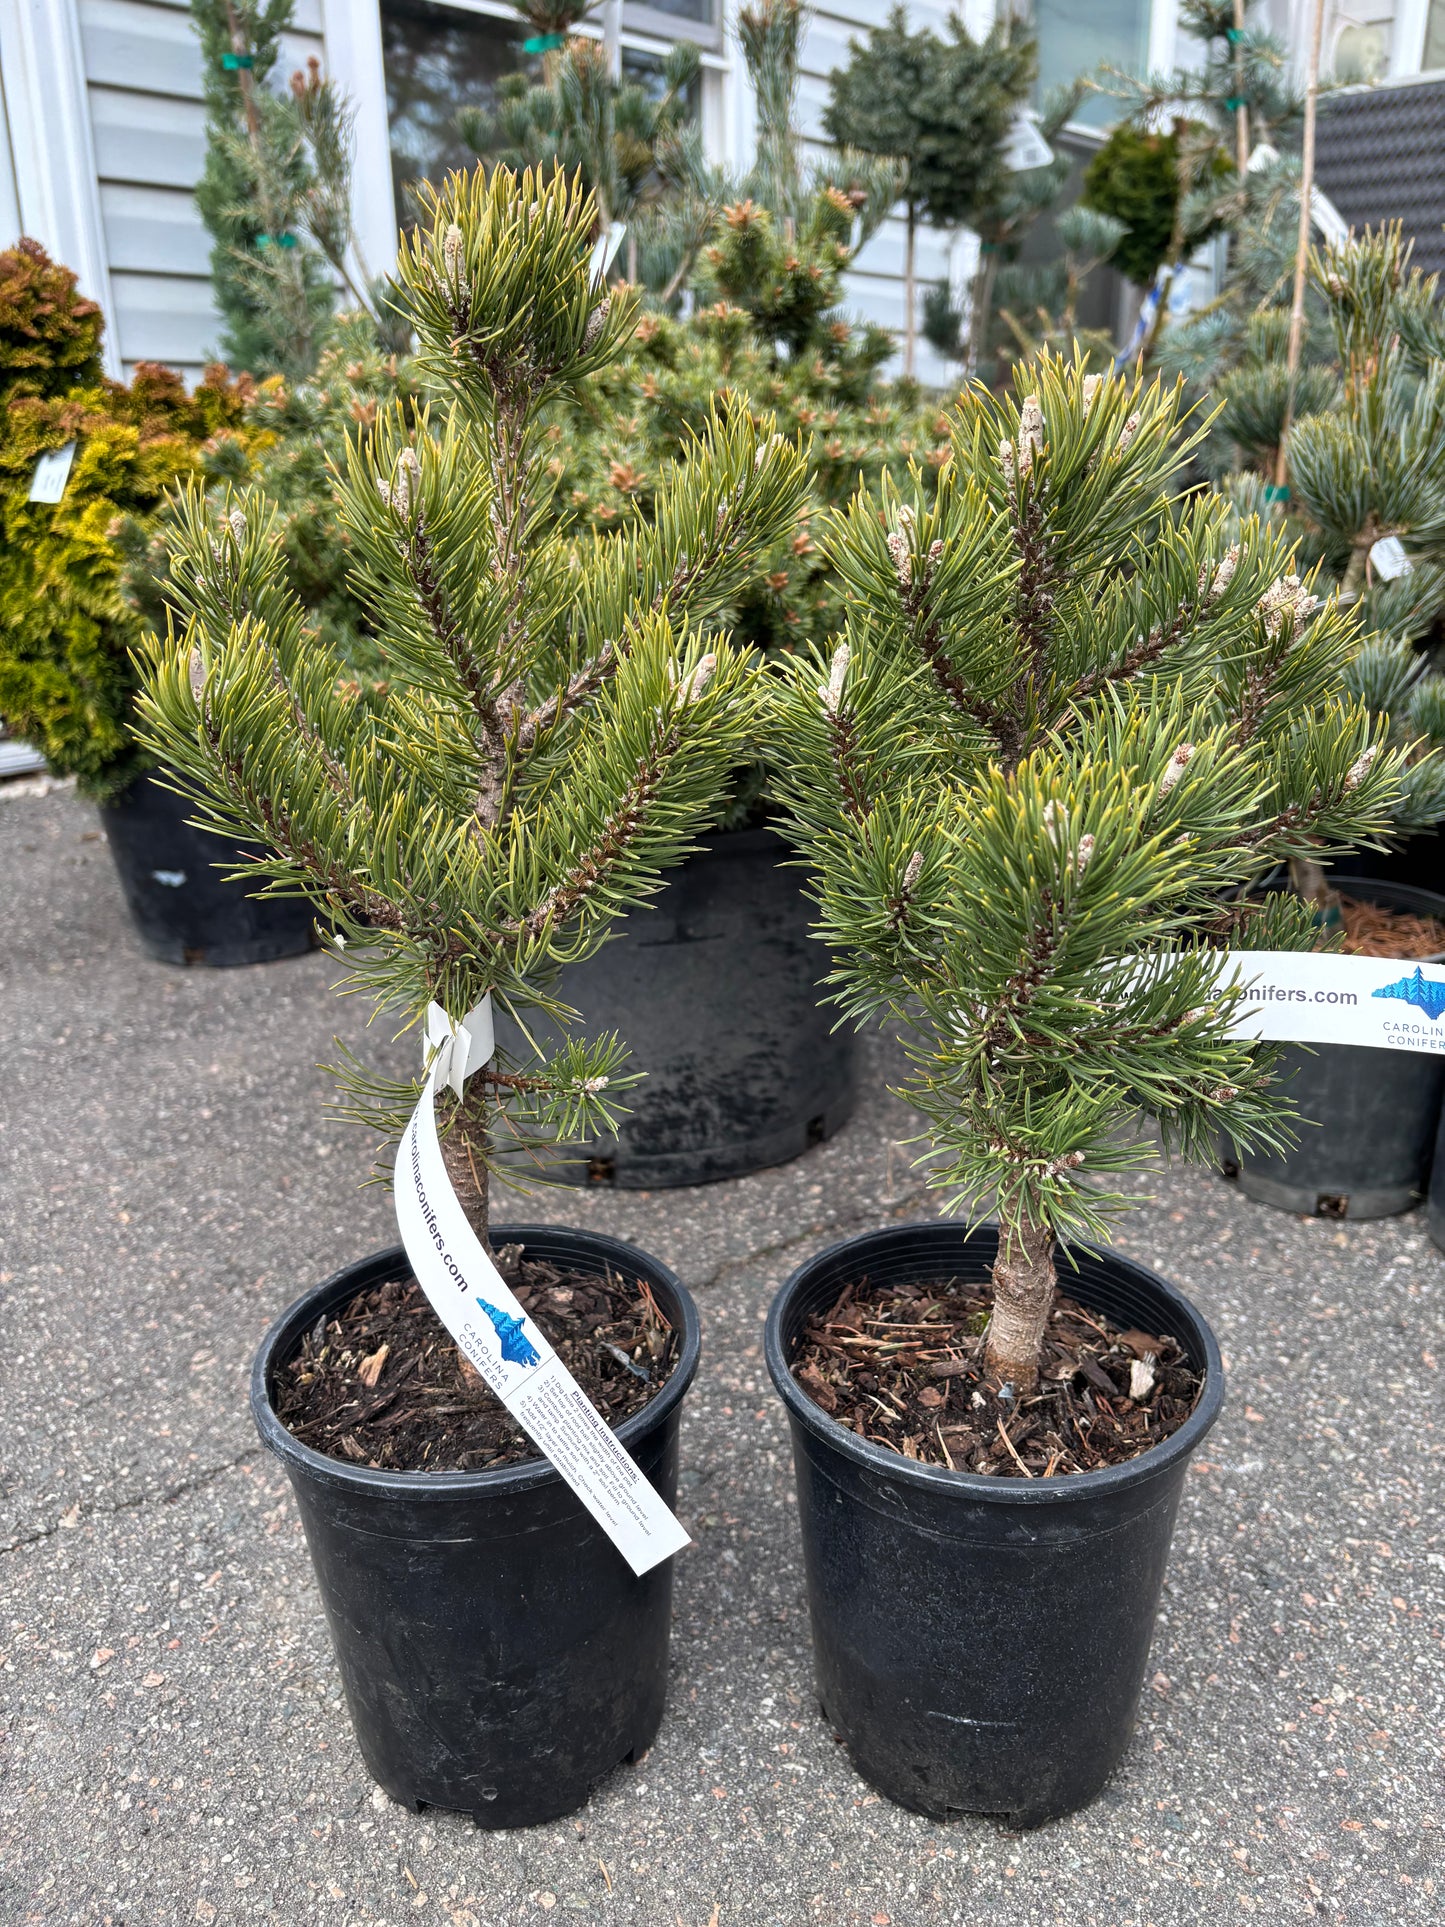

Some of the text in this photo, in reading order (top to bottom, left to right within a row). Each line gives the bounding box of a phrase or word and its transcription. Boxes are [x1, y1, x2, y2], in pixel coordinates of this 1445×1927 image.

[459, 1333, 503, 1390] CONIFERS
[463, 1323, 509, 1382] CAROLINA
[571, 1390, 639, 1482] Planting Instructions:
